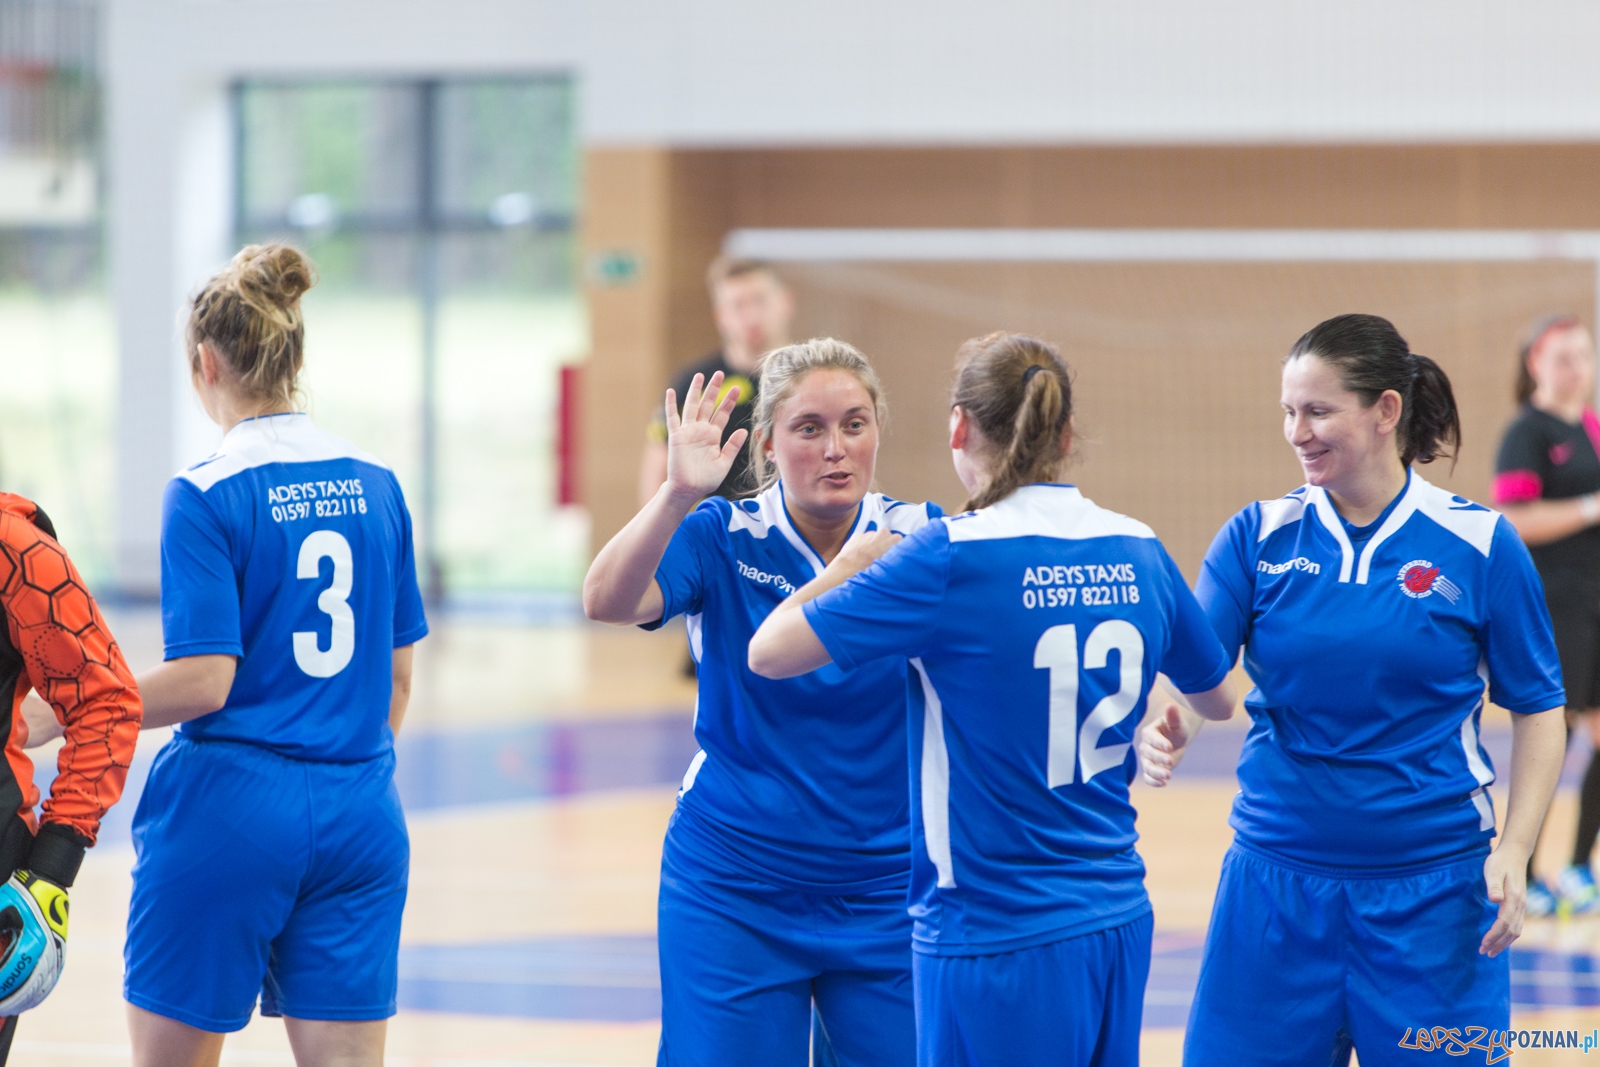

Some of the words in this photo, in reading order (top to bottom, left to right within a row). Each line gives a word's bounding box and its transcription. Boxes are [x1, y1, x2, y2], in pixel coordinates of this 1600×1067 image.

[268, 482, 317, 505] ADEYS
[315, 478, 363, 497] TAXIS
[271, 501, 310, 523] 01597
[315, 497, 368, 517] 822118
[1022, 565, 1085, 587] ADEYS
[1084, 563, 1136, 583] TAXIS
[292, 529, 355, 678] 3
[1022, 587, 1077, 609] 01597
[1081, 585, 1140, 606] 822118
[1033, 619, 1145, 790] 12
